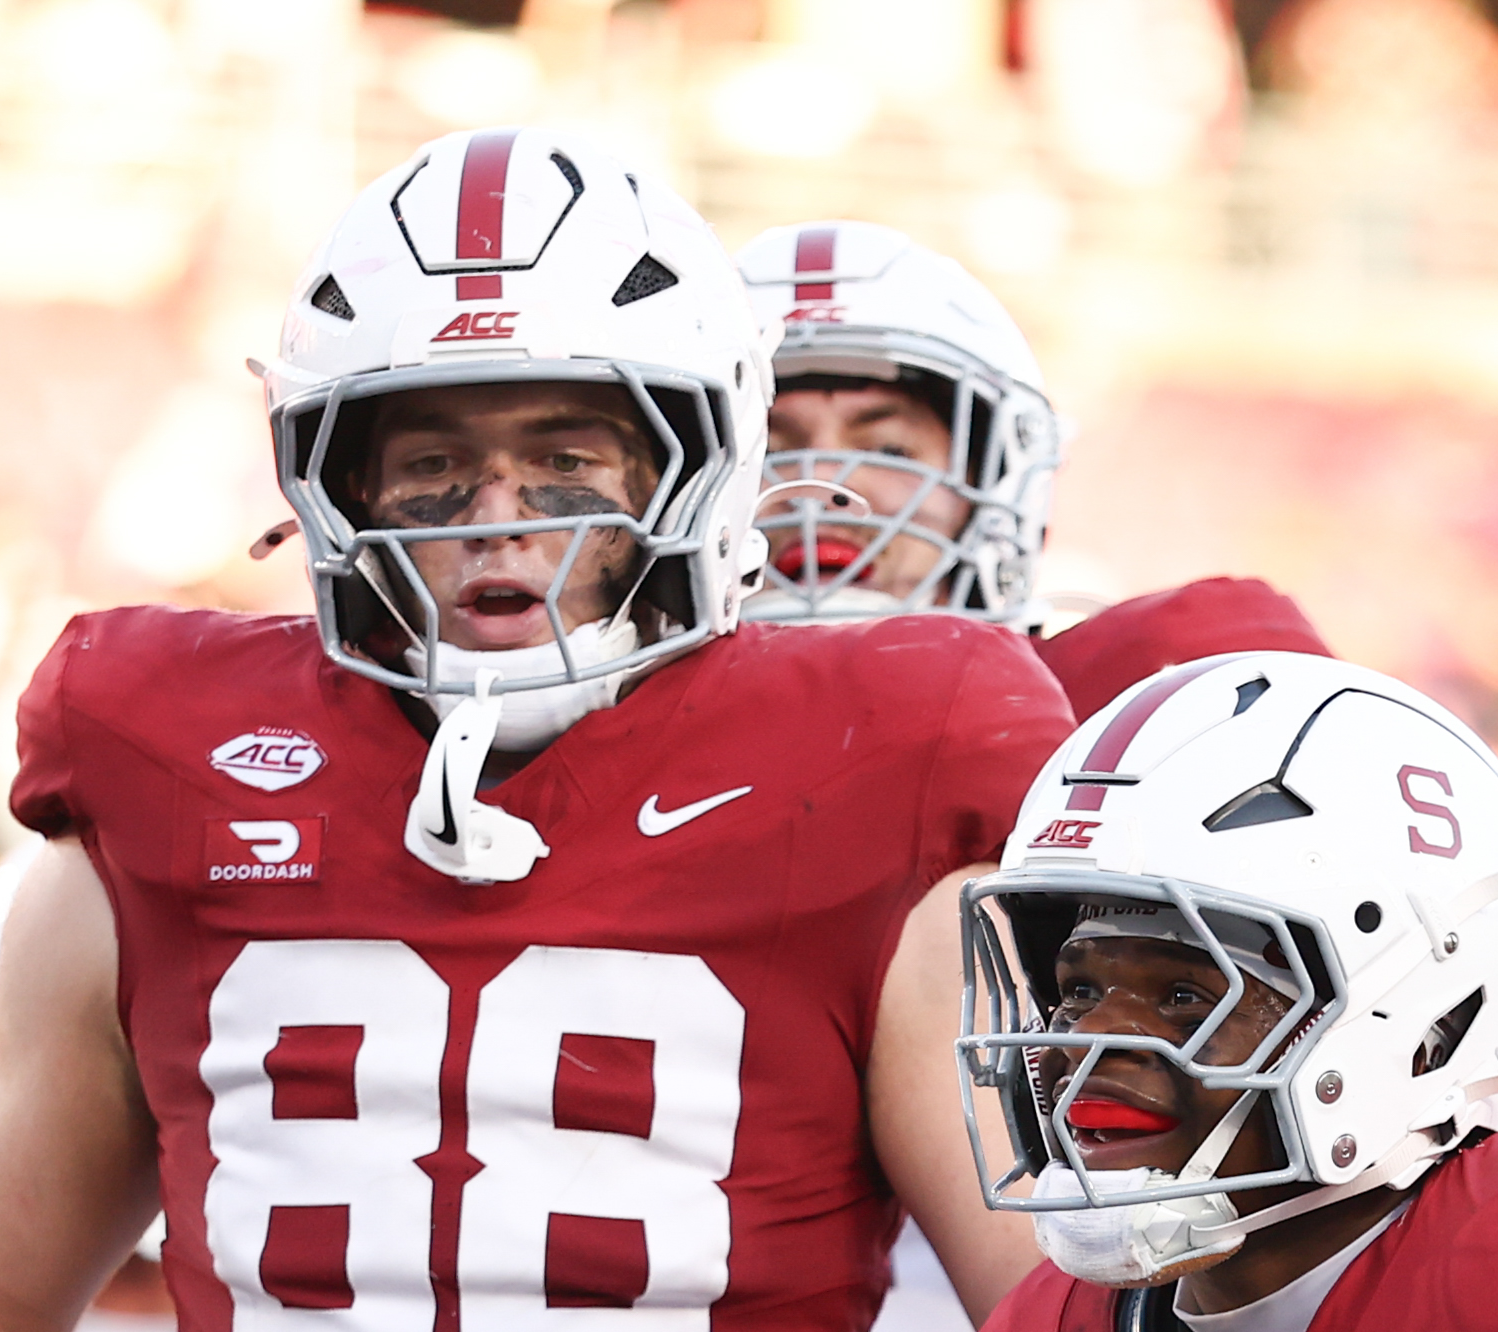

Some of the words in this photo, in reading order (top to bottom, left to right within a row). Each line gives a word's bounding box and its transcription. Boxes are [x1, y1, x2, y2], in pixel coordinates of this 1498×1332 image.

[434, 311, 521, 338] ACC
[224, 743, 313, 769] ACC
[1397, 764, 1463, 860] S
[1032, 819, 1103, 845] ACC
[209, 863, 314, 881] DOORDASH
